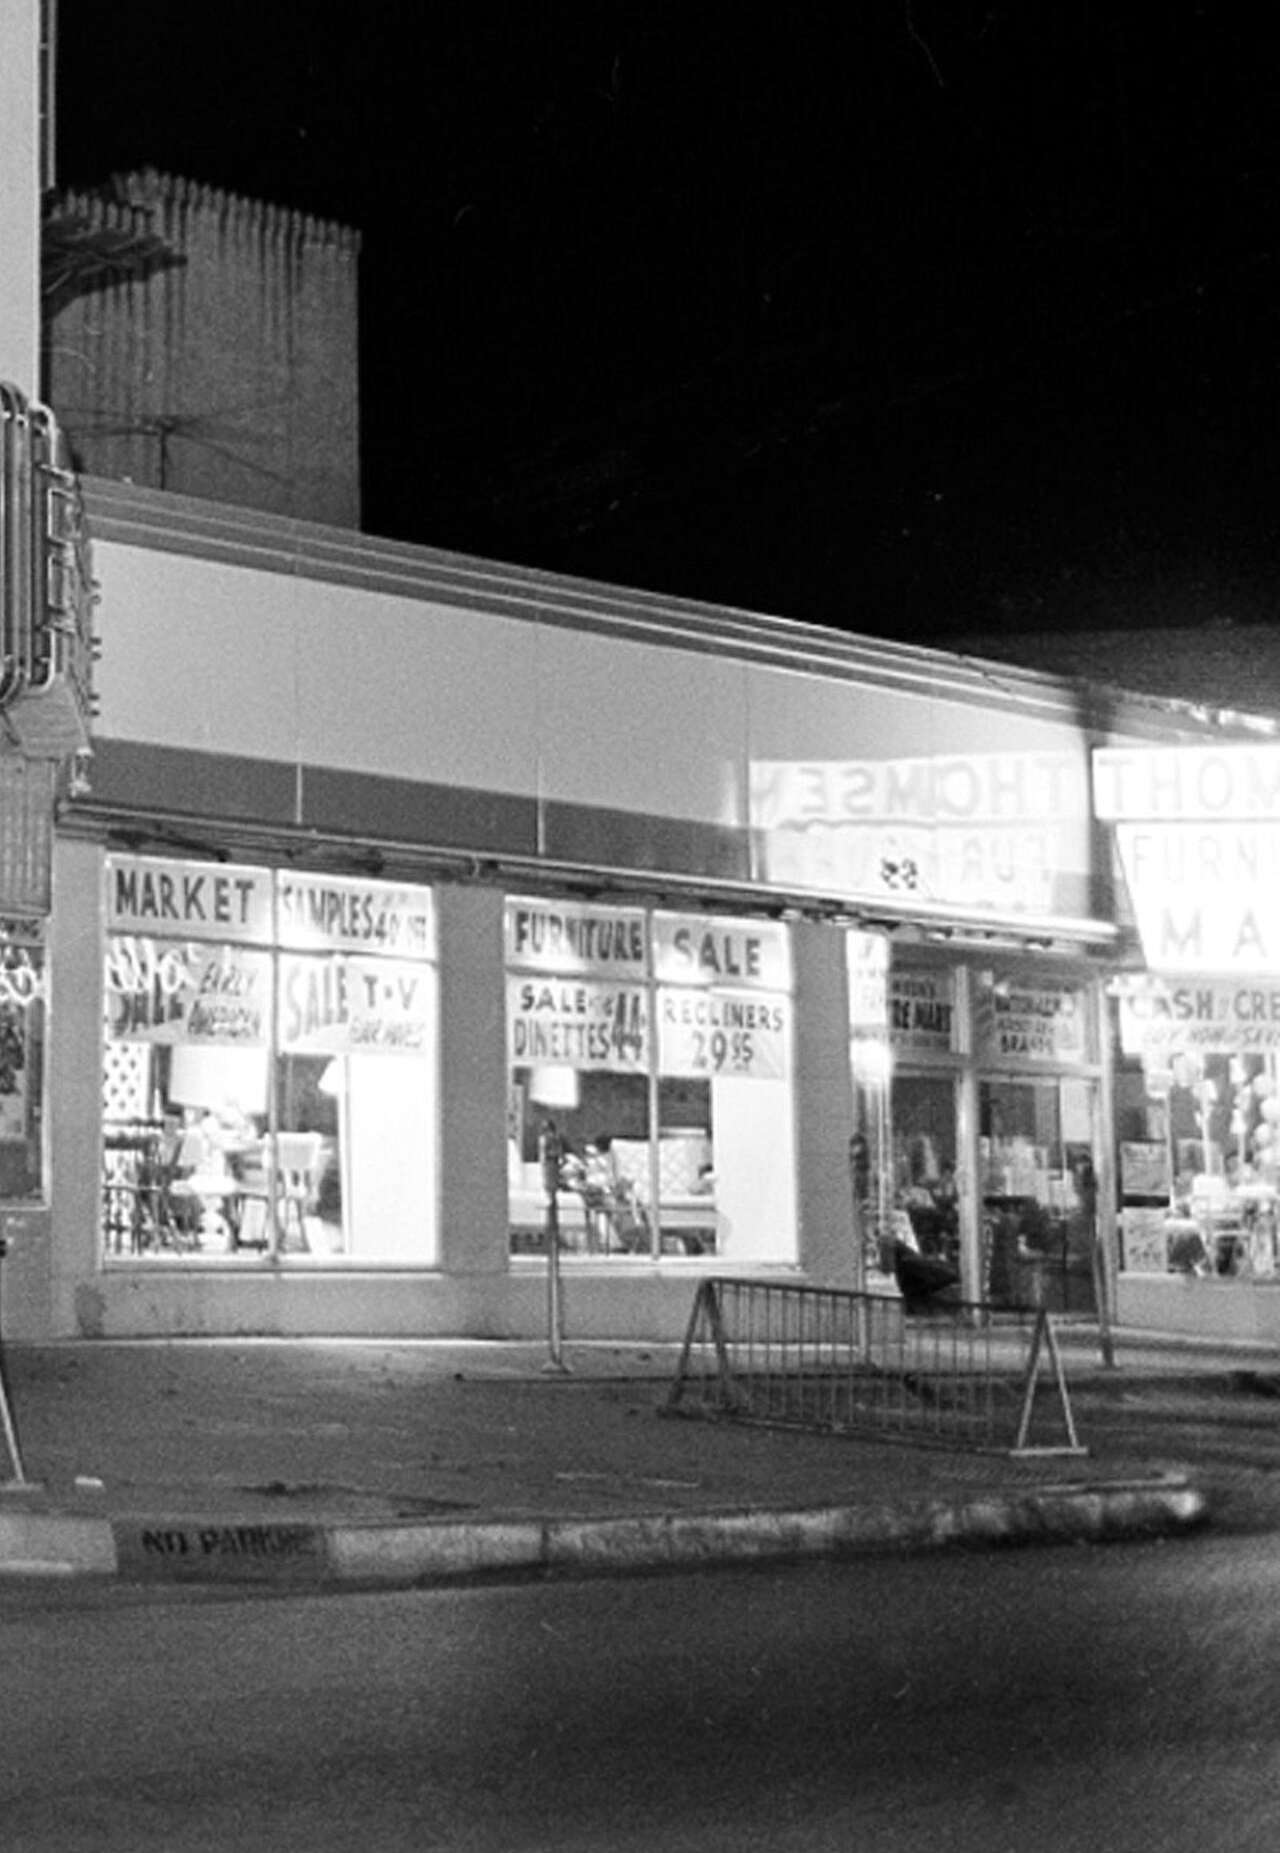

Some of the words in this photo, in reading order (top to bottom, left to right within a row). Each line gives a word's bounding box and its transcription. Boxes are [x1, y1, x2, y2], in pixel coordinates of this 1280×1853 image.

[115, 868, 255, 924] MARKET
[513, 910, 644, 963] FURNITURE
[673, 928, 762, 977] SALE
[520, 983, 586, 1014] SALE
[662, 997, 784, 1032] RECLINERS
[513, 1018, 611, 1061] DINETTES
[142, 1529, 189, 1556] NO
